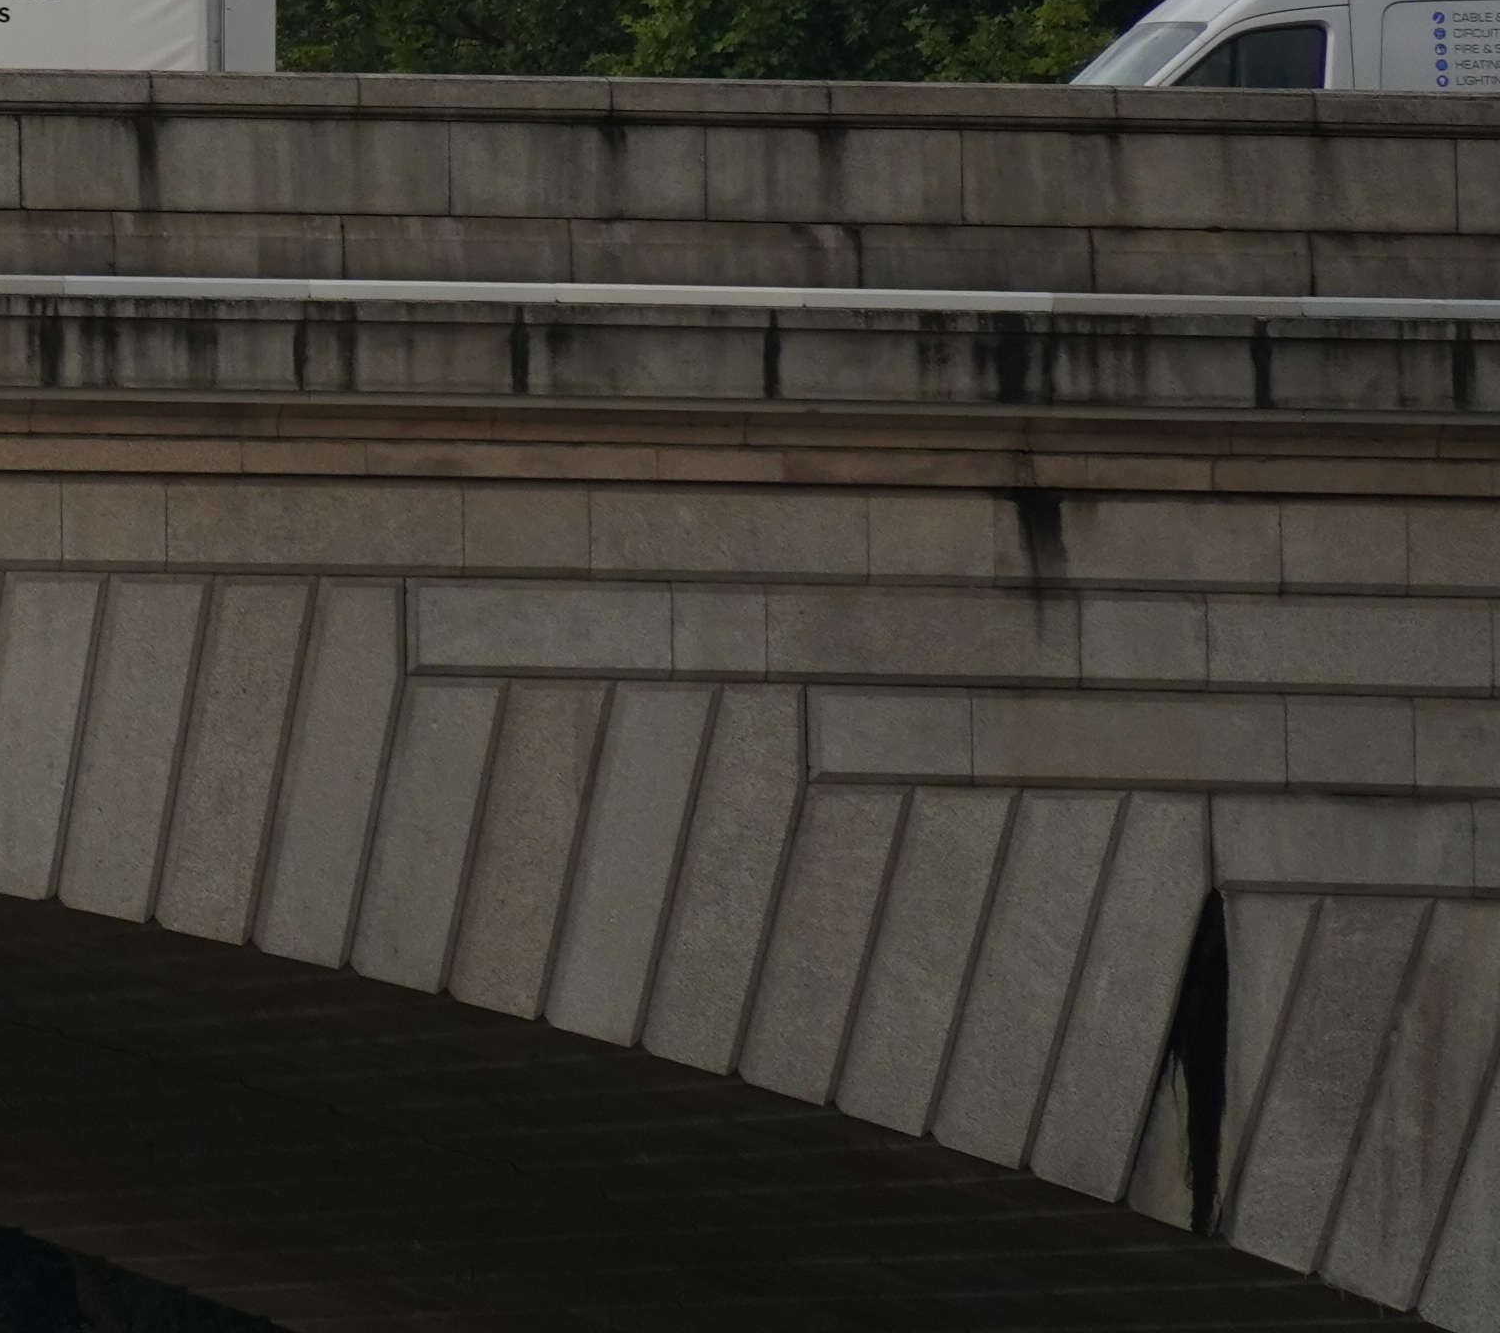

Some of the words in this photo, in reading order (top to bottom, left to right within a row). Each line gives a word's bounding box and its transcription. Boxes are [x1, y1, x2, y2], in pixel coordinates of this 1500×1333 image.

[1452, 12, 1493, 23] CABLE
[1454, 43, 1480, 54] FIRE
[1483, 43, 1493, 54] &
